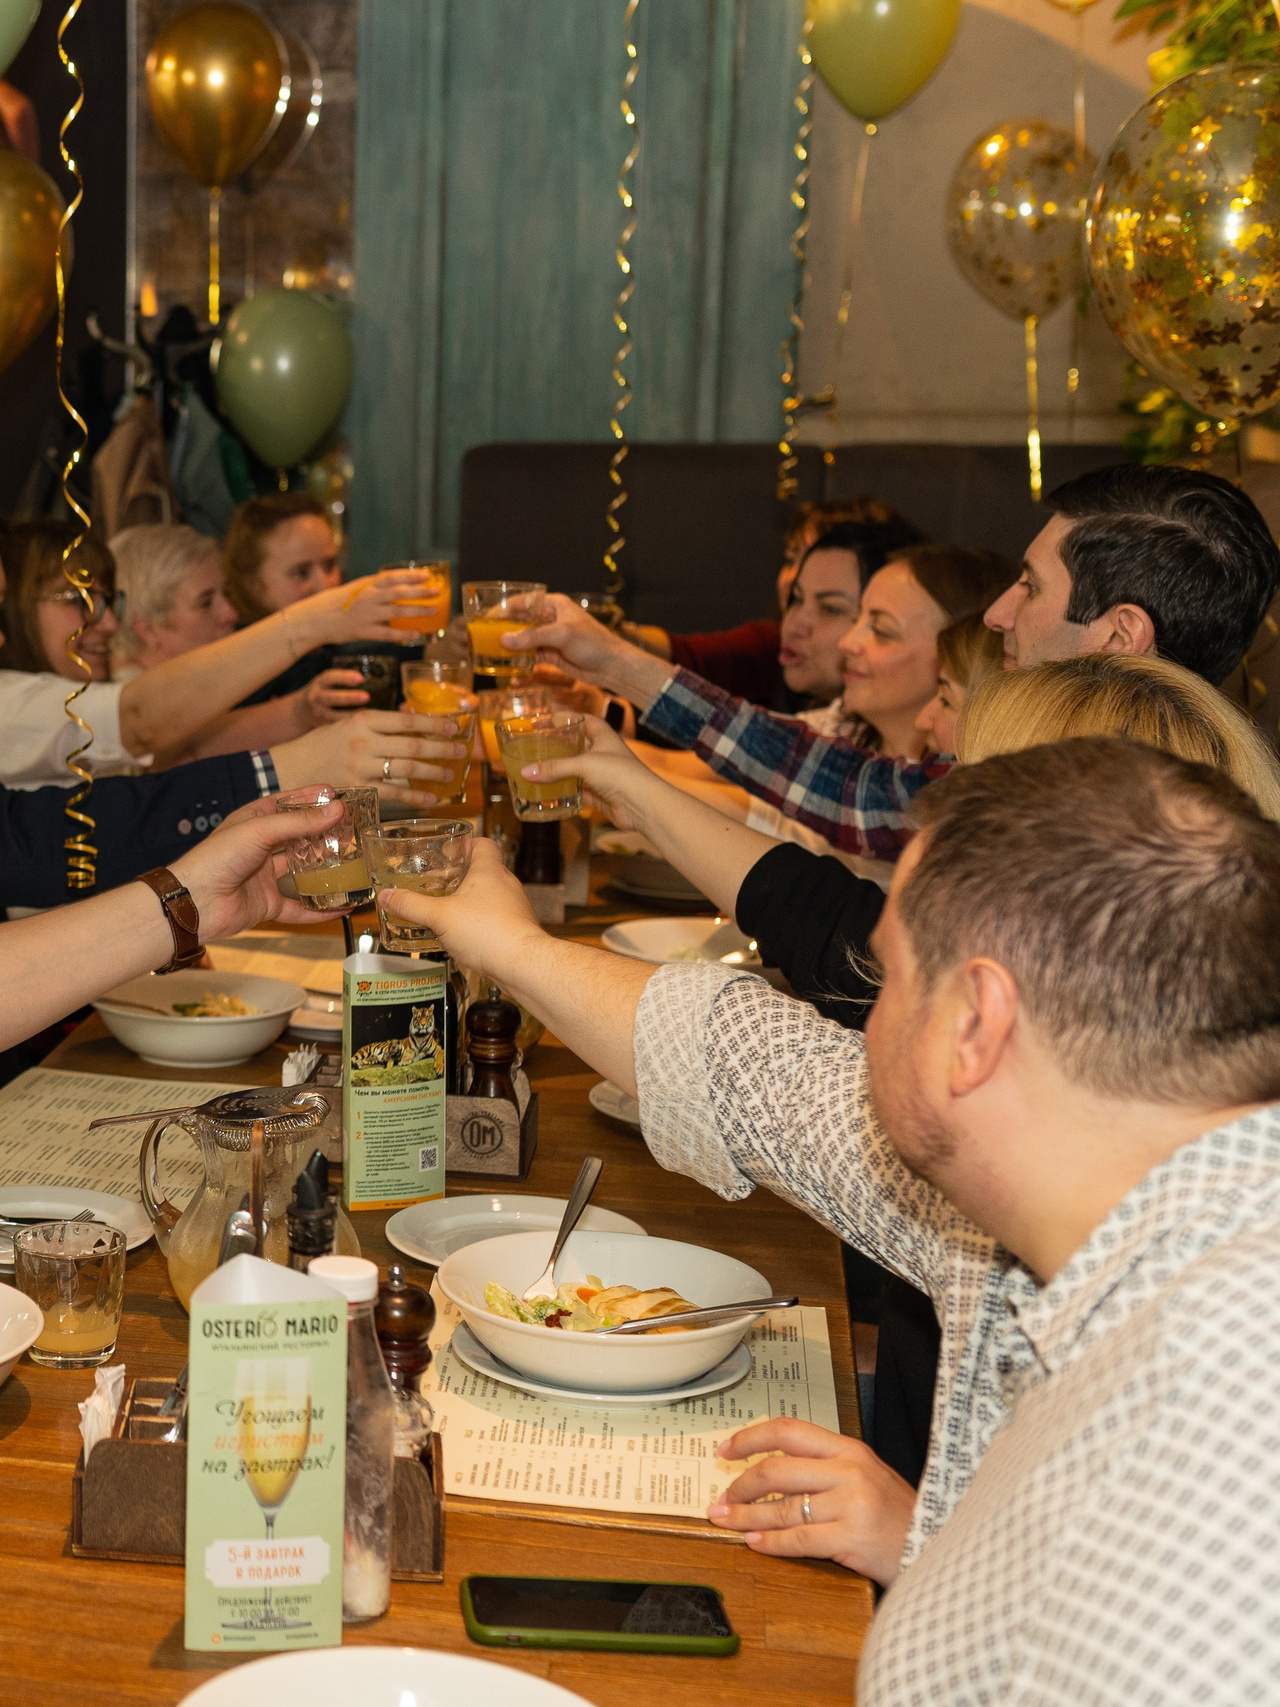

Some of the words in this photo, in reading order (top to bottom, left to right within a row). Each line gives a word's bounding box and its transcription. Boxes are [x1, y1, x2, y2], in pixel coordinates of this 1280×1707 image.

[375, 980, 408, 990] TIGRUS
[410, 974, 444, 987] PROJECT
[356, 1131, 361, 1140] 2
[470, 1120, 495, 1148] OM
[285, 1314, 339, 1337] MARIO
[215, 1398, 325, 1430] Угощаем
[214, 1431, 325, 1455] игристым
[200, 1458, 228, 1474] на
[233, 1444, 336, 1482] завтрак!
[227, 1545, 252, 1564] 5-Й
[257, 1545, 306, 1560] ЗАВТРАК
[248, 1565, 302, 1580] ПОДАРОК
